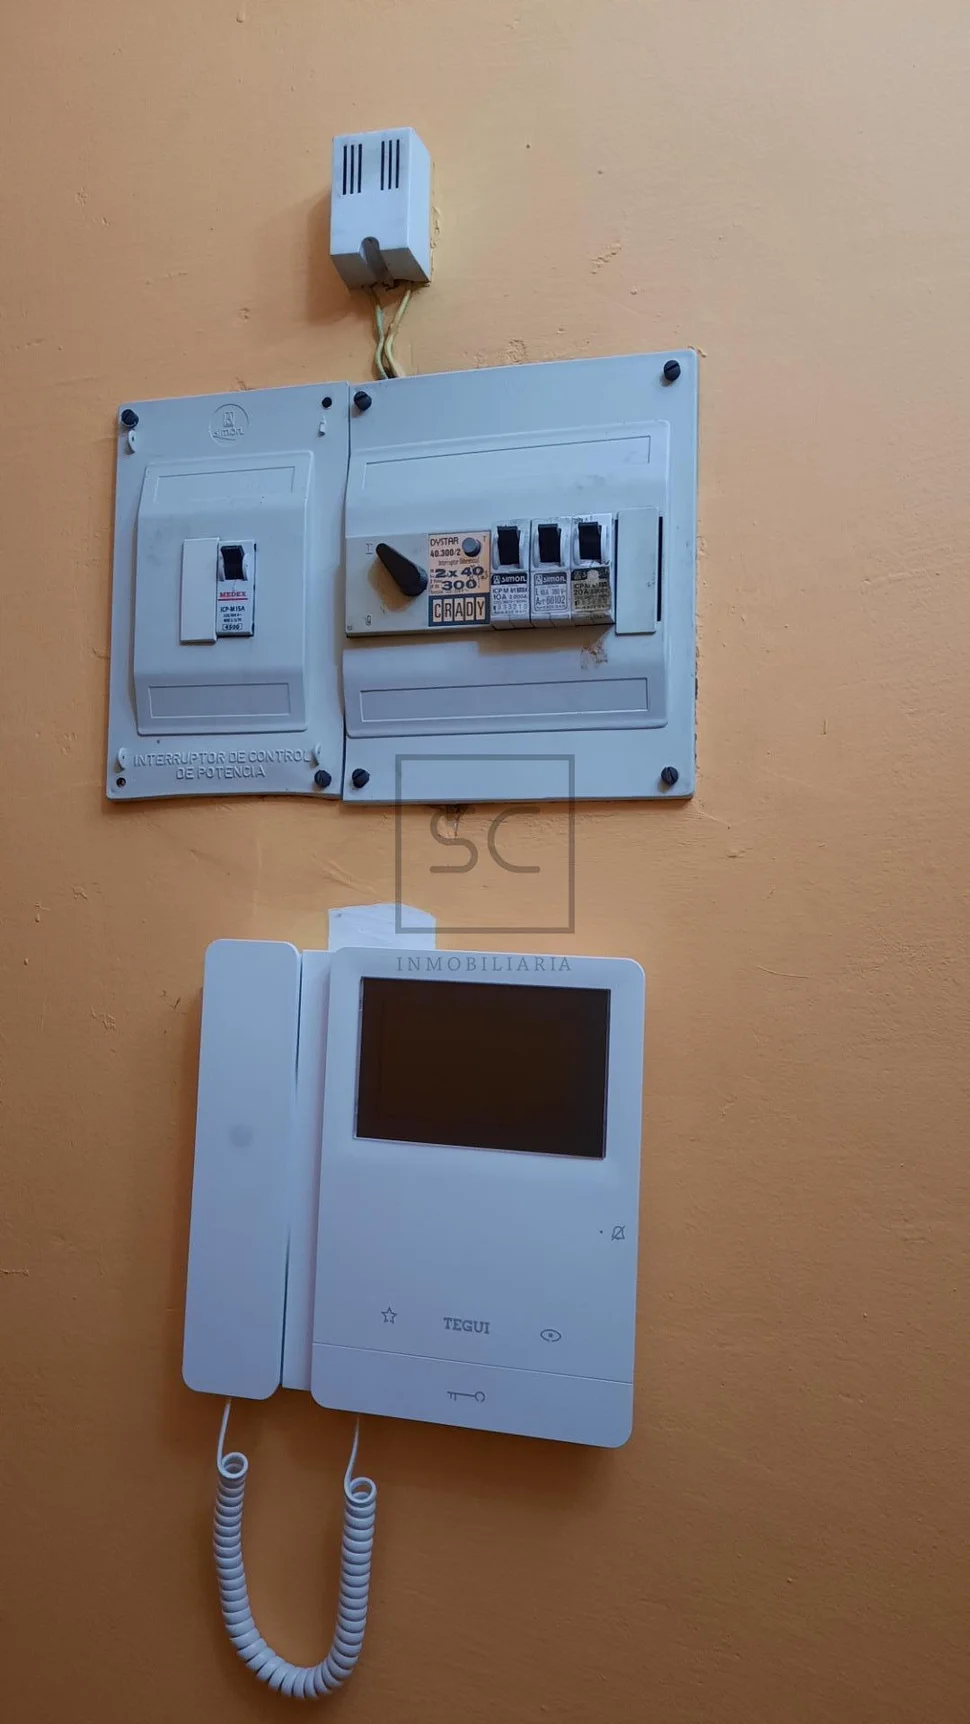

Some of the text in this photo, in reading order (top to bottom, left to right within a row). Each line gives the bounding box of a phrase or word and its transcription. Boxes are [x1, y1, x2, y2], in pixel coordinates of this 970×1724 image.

[430, 536, 459, 547] DYSTAR
[441, 579, 478, 591] 300
[434, 601, 485, 618] CRADY
[133, 748, 312, 767] INTERRUPTOR DE CONTROL
[176, 764, 266, 780] DE POTENCIA
[443, 1316, 491, 1335] TEGUI
